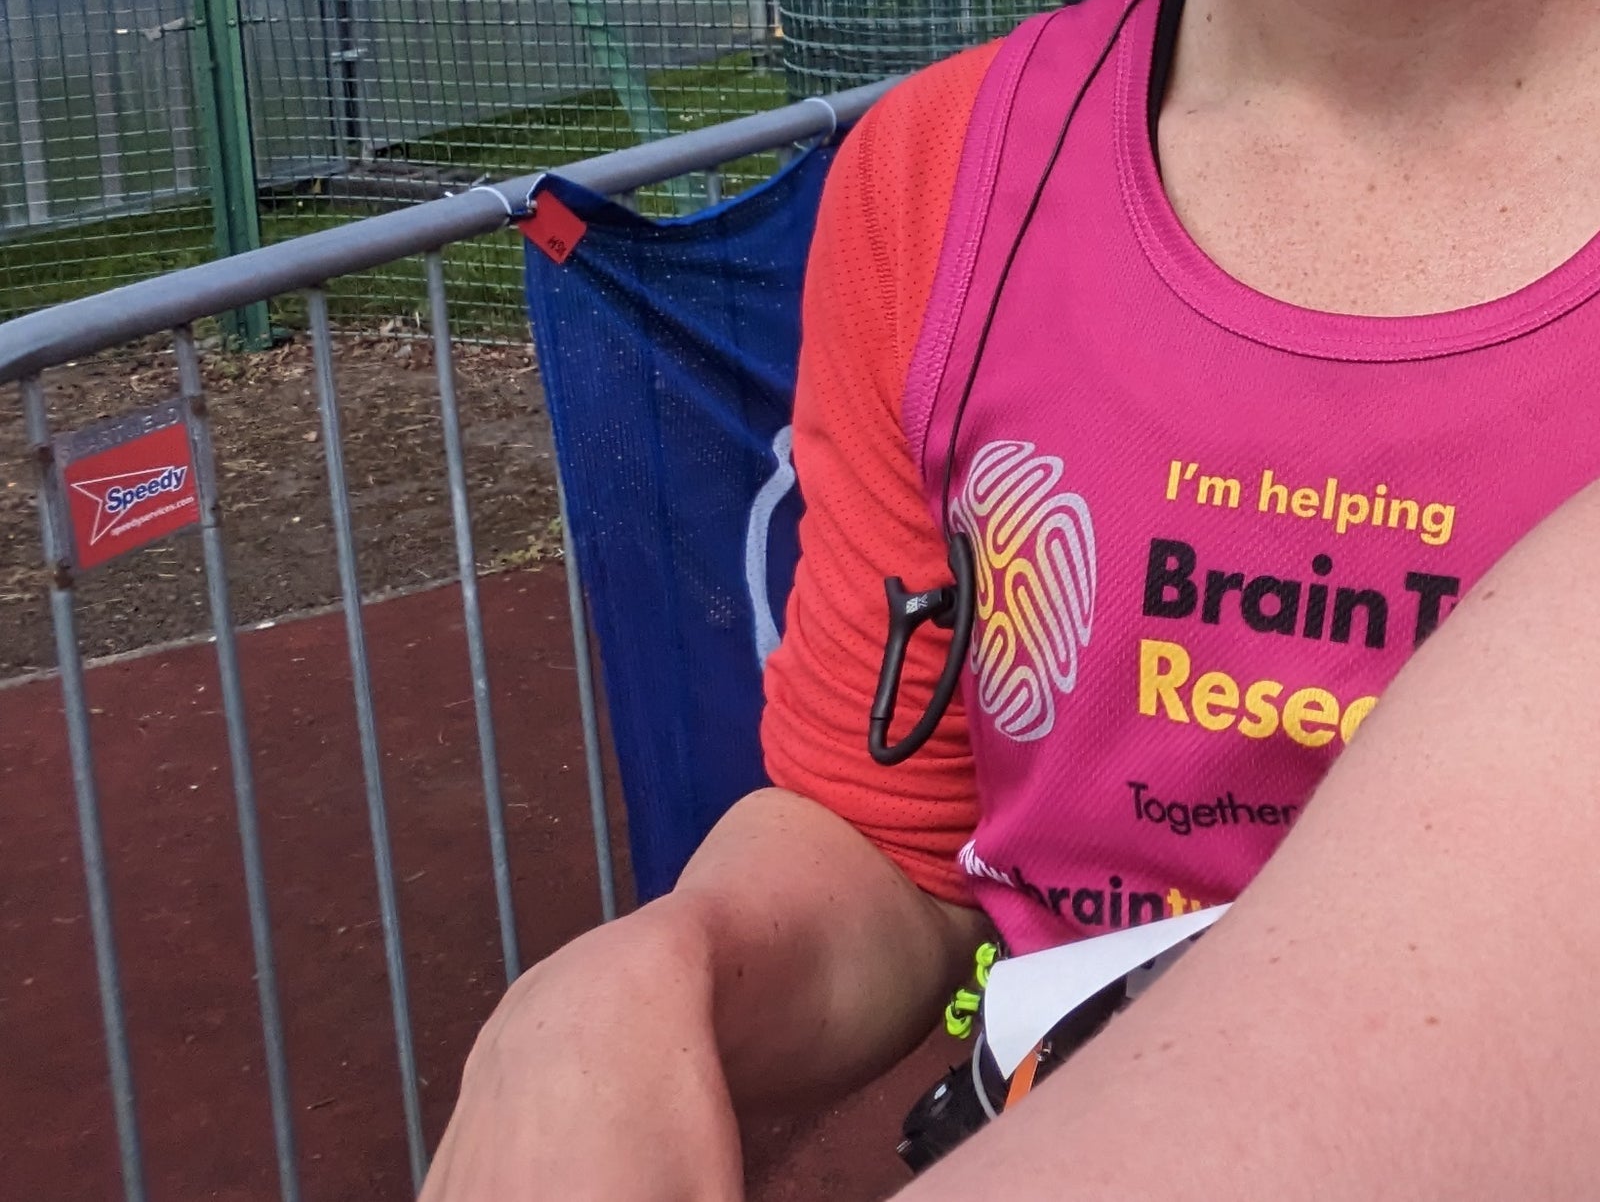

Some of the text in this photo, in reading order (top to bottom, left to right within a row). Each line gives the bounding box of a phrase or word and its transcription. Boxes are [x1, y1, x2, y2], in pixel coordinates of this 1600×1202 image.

[106, 466, 187, 512] Speedy
[1166, 460, 1456, 546] I’m helping
[1142, 537, 1460, 650] Brain T
[1127, 780, 1300, 836] Together
